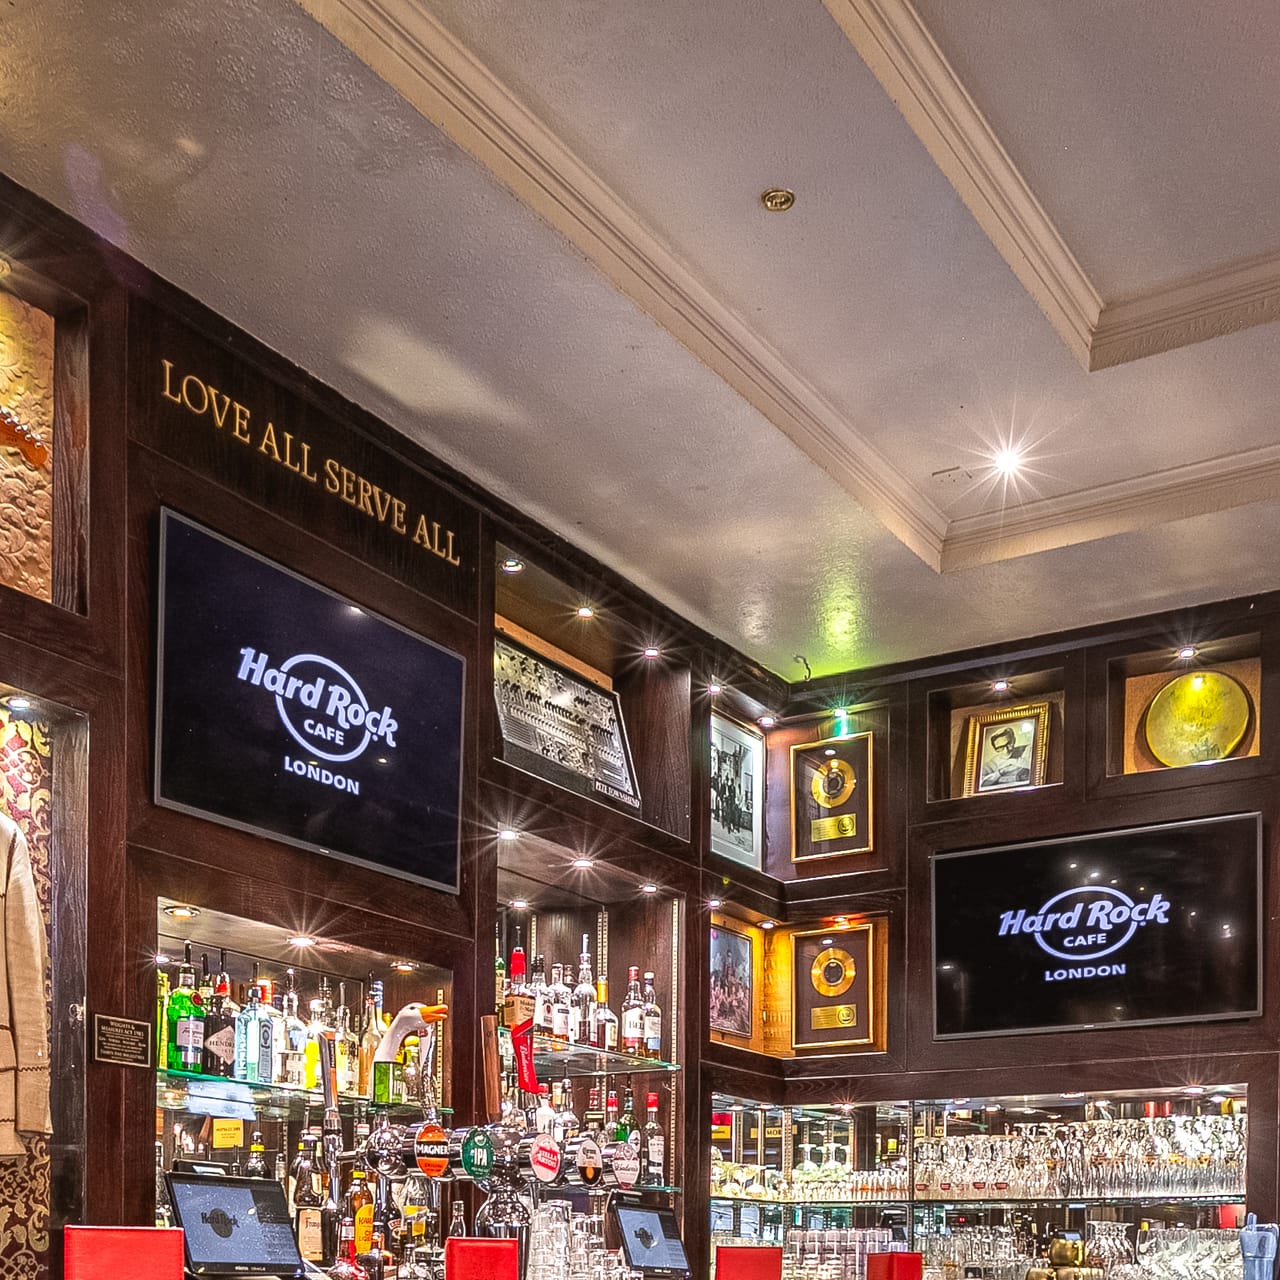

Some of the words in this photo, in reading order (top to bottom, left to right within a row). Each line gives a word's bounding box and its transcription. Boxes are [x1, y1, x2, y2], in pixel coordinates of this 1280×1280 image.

[161, 359, 251, 444] LOVE
[259, 422, 317, 482] ALL
[324, 459, 407, 535] SERVE
[413, 514, 461, 566] ALL
[237, 646, 325, 709] Hard
[325, 684, 398, 747] Rock
[303, 719, 345, 746] CAFE
[284, 755, 360, 795] LONDON
[998, 903, 1084, 936] Hard
[1086, 894, 1170, 930] Rock
[1063, 933, 1107, 947] CAFE
[1045, 963, 1126, 981] LONDON
